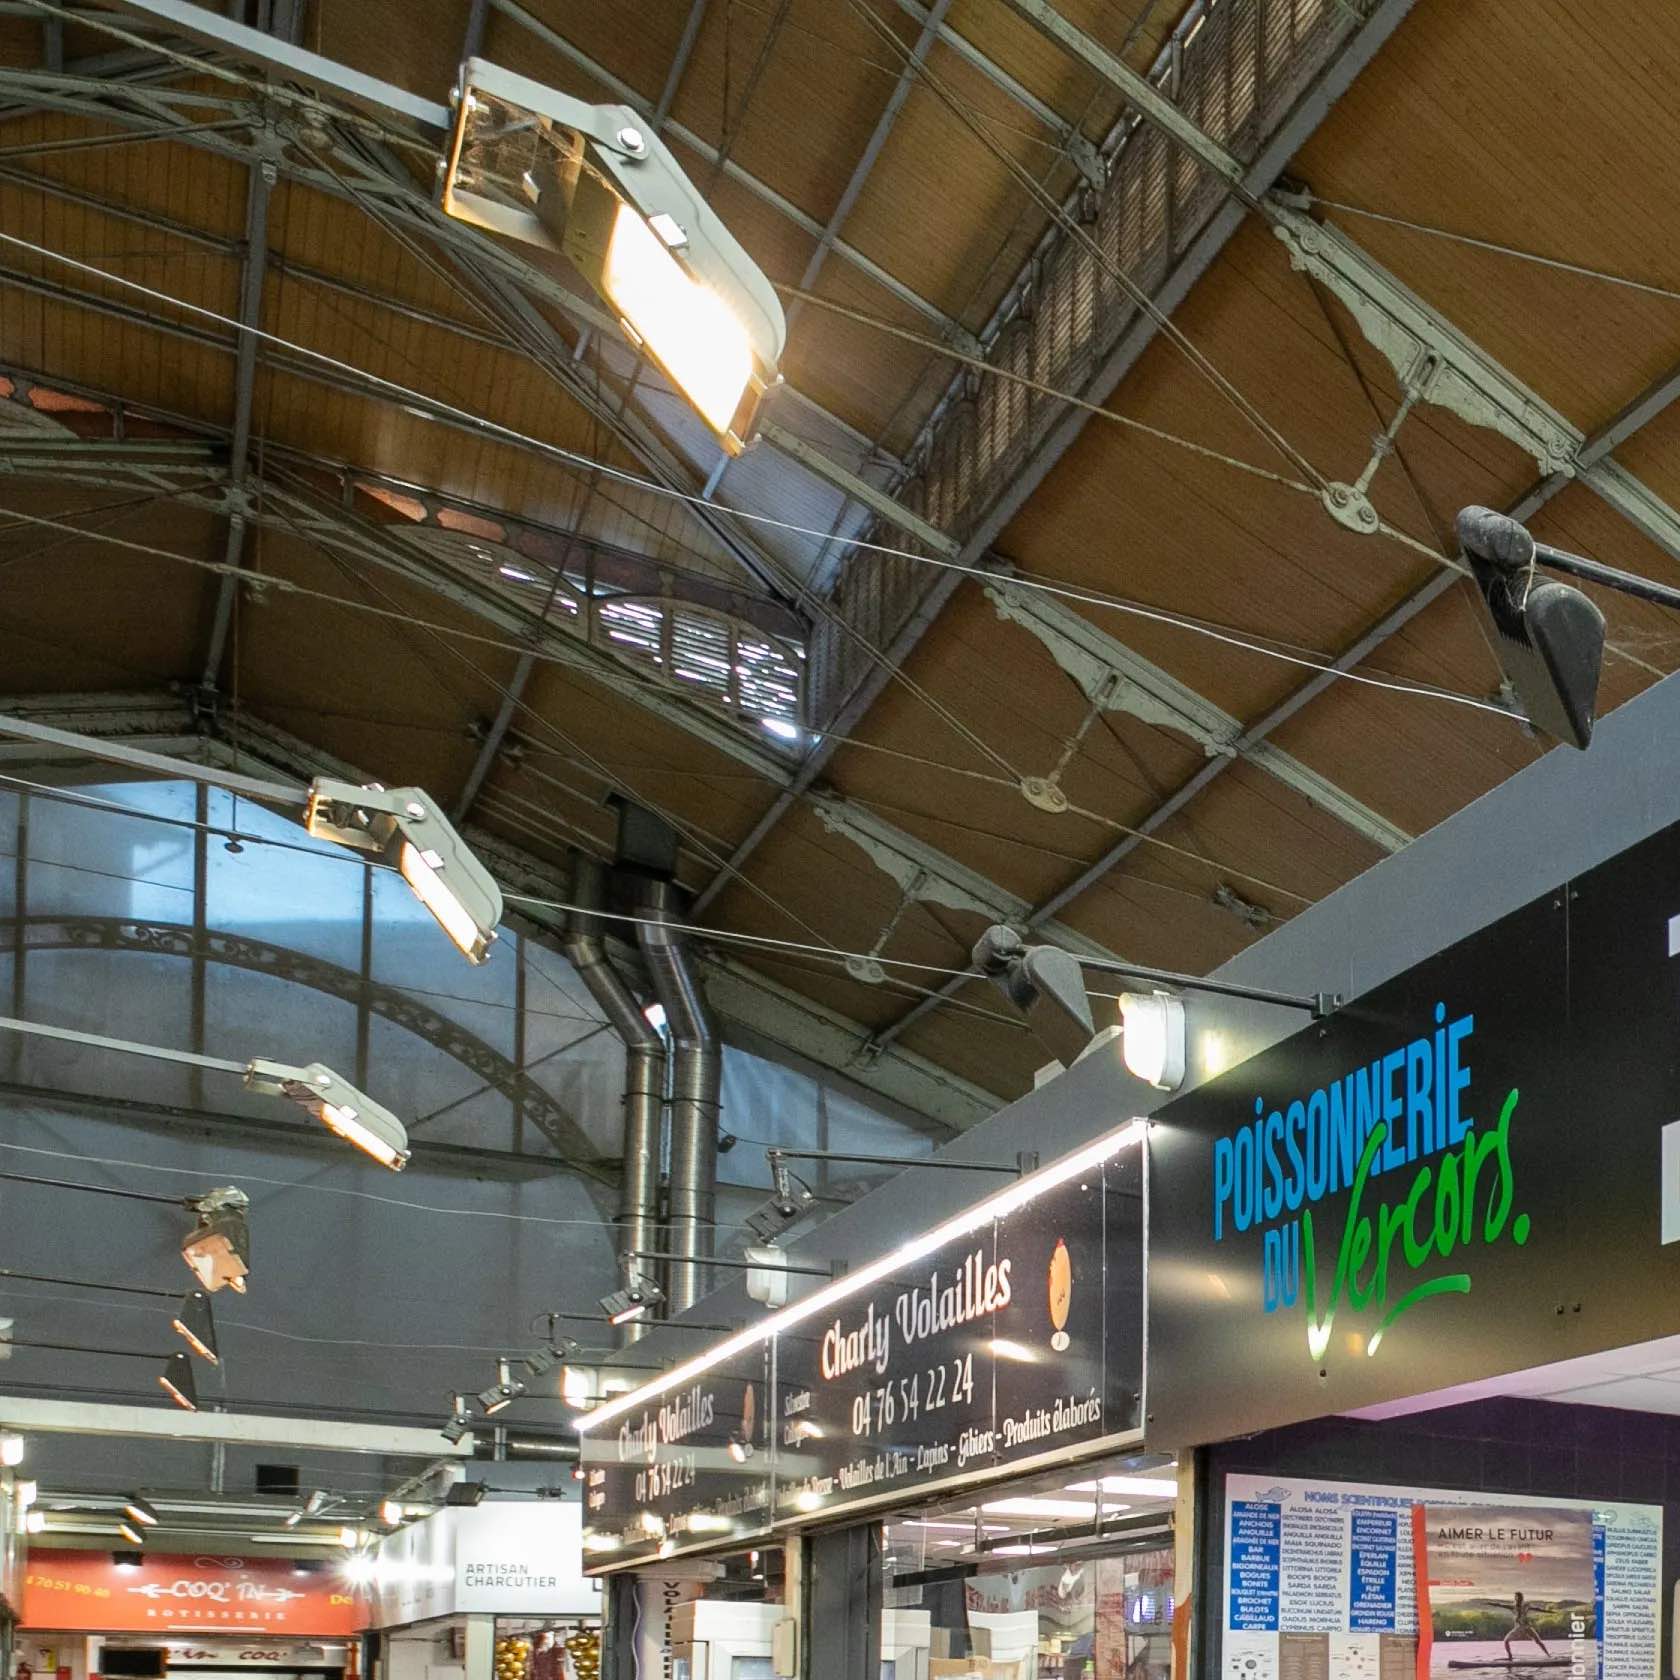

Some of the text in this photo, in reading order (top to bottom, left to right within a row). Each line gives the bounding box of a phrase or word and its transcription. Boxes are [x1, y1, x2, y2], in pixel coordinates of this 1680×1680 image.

[1264, 1221, 1298, 1316] DU
[822, 1249, 1012, 1380] Charly Volailles
[618, 1385, 714, 1462] Charly Volailles
[852, 1396, 871, 1436] 04
[877, 1380, 895, 1433] 76
[901, 1374, 919, 1423] 54
[927, 1365, 946, 1411] 22
[953, 1353, 974, 1405] 24
[917, 1443, 949, 1474] Lapins
[958, 1428, 994, 1467] Gibiers
[1003, 1410, 1050, 1448] Produits
[1053, 1388, 1100, 1431] élaborés
[649, 1465, 660, 1500] 76
[465, 1563, 528, 1575] ARTISAN
[1438, 1527, 1553, 1540] AIMER LE FUTUR
[465, 1576, 557, 1588] CHARCUTIER
